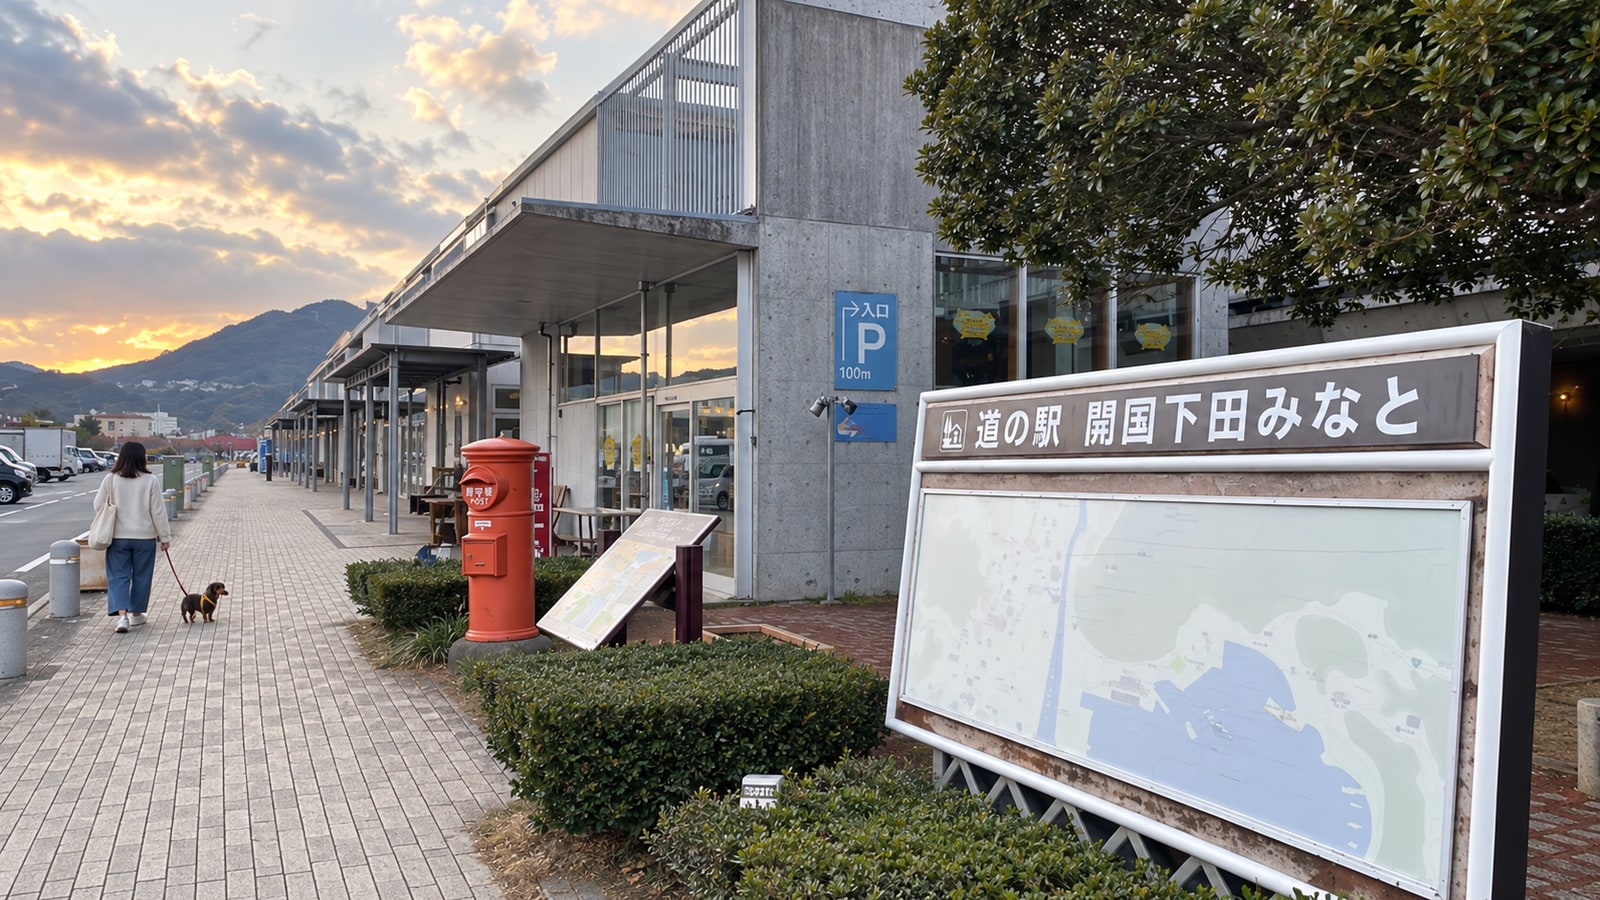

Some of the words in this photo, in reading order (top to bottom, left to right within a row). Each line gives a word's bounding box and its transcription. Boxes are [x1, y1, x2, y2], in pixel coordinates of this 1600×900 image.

[861, 302, 889, 319] 入口
[858, 322, 886, 364] P
[839, 366, 871, 380] 100m
[974, 403, 1063, 450] 道の駅
[1083, 376, 1420, 447] 開国下田みなと
